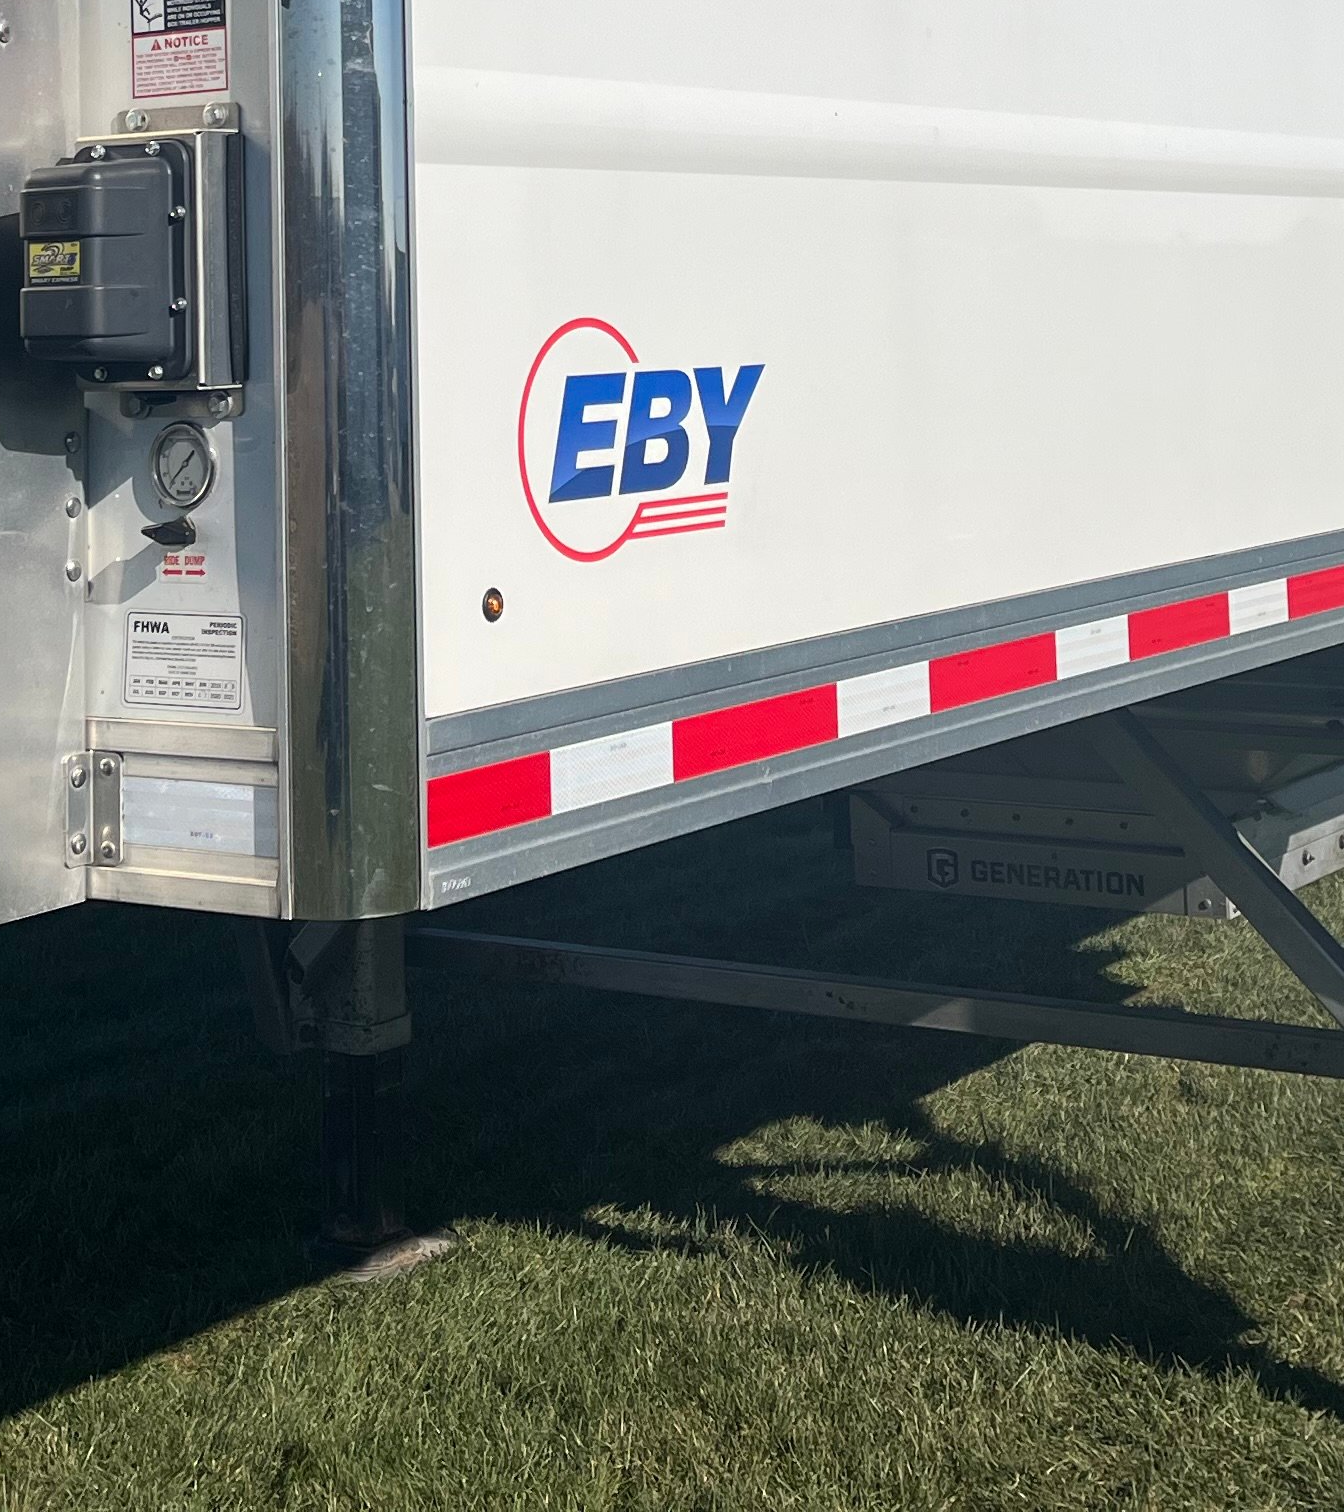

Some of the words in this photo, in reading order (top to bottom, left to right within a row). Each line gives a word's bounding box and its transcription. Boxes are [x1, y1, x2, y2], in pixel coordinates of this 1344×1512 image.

[164, 34, 209, 49] NOTICE
[548, 363, 766, 504] EBY
[184, 555, 205, 566] DUMP
[133, 620, 170, 634] FHWA
[970, 859, 1145, 897] GENERATION
